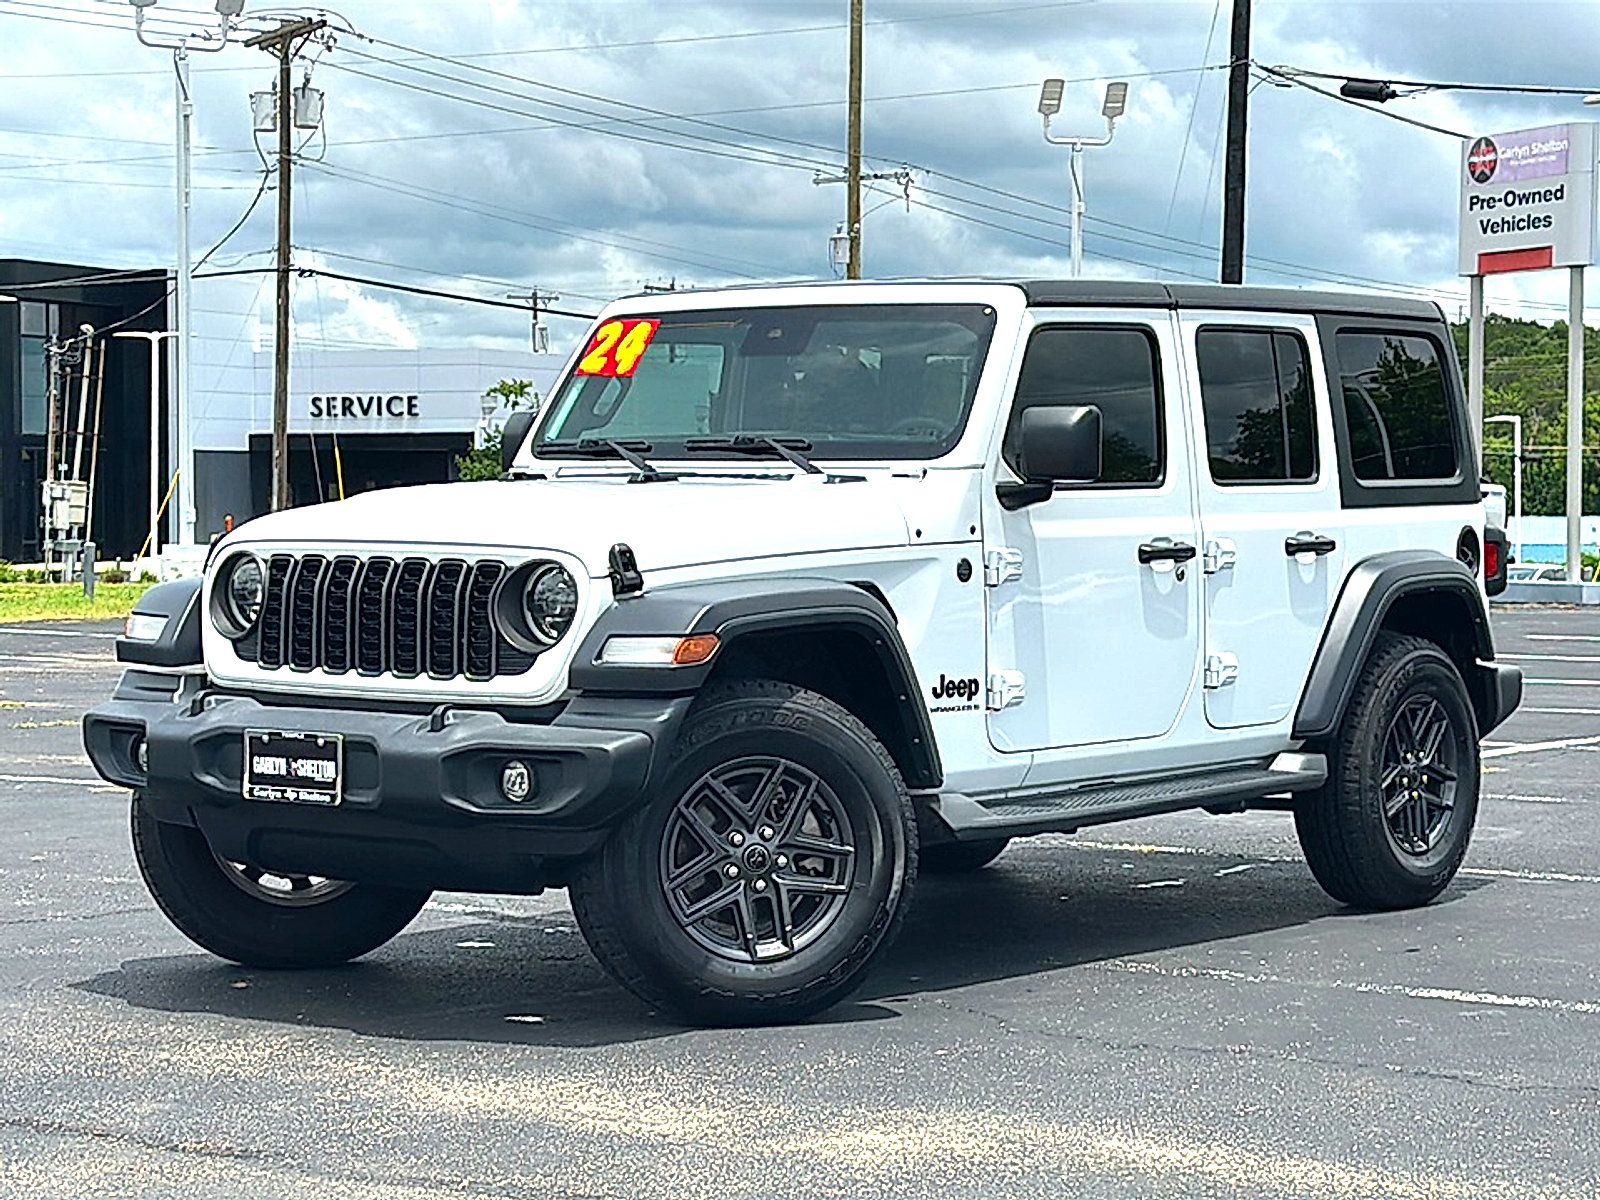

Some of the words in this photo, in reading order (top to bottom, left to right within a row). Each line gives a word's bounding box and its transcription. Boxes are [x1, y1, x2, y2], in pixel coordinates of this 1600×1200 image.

[1469, 184, 1565, 211] Pre-Owned
[1479, 214, 1553, 234] Vehicles
[579, 321, 652, 374] 24
[310, 395, 419, 418] SERVICE
[932, 674, 979, 701] Jeep
